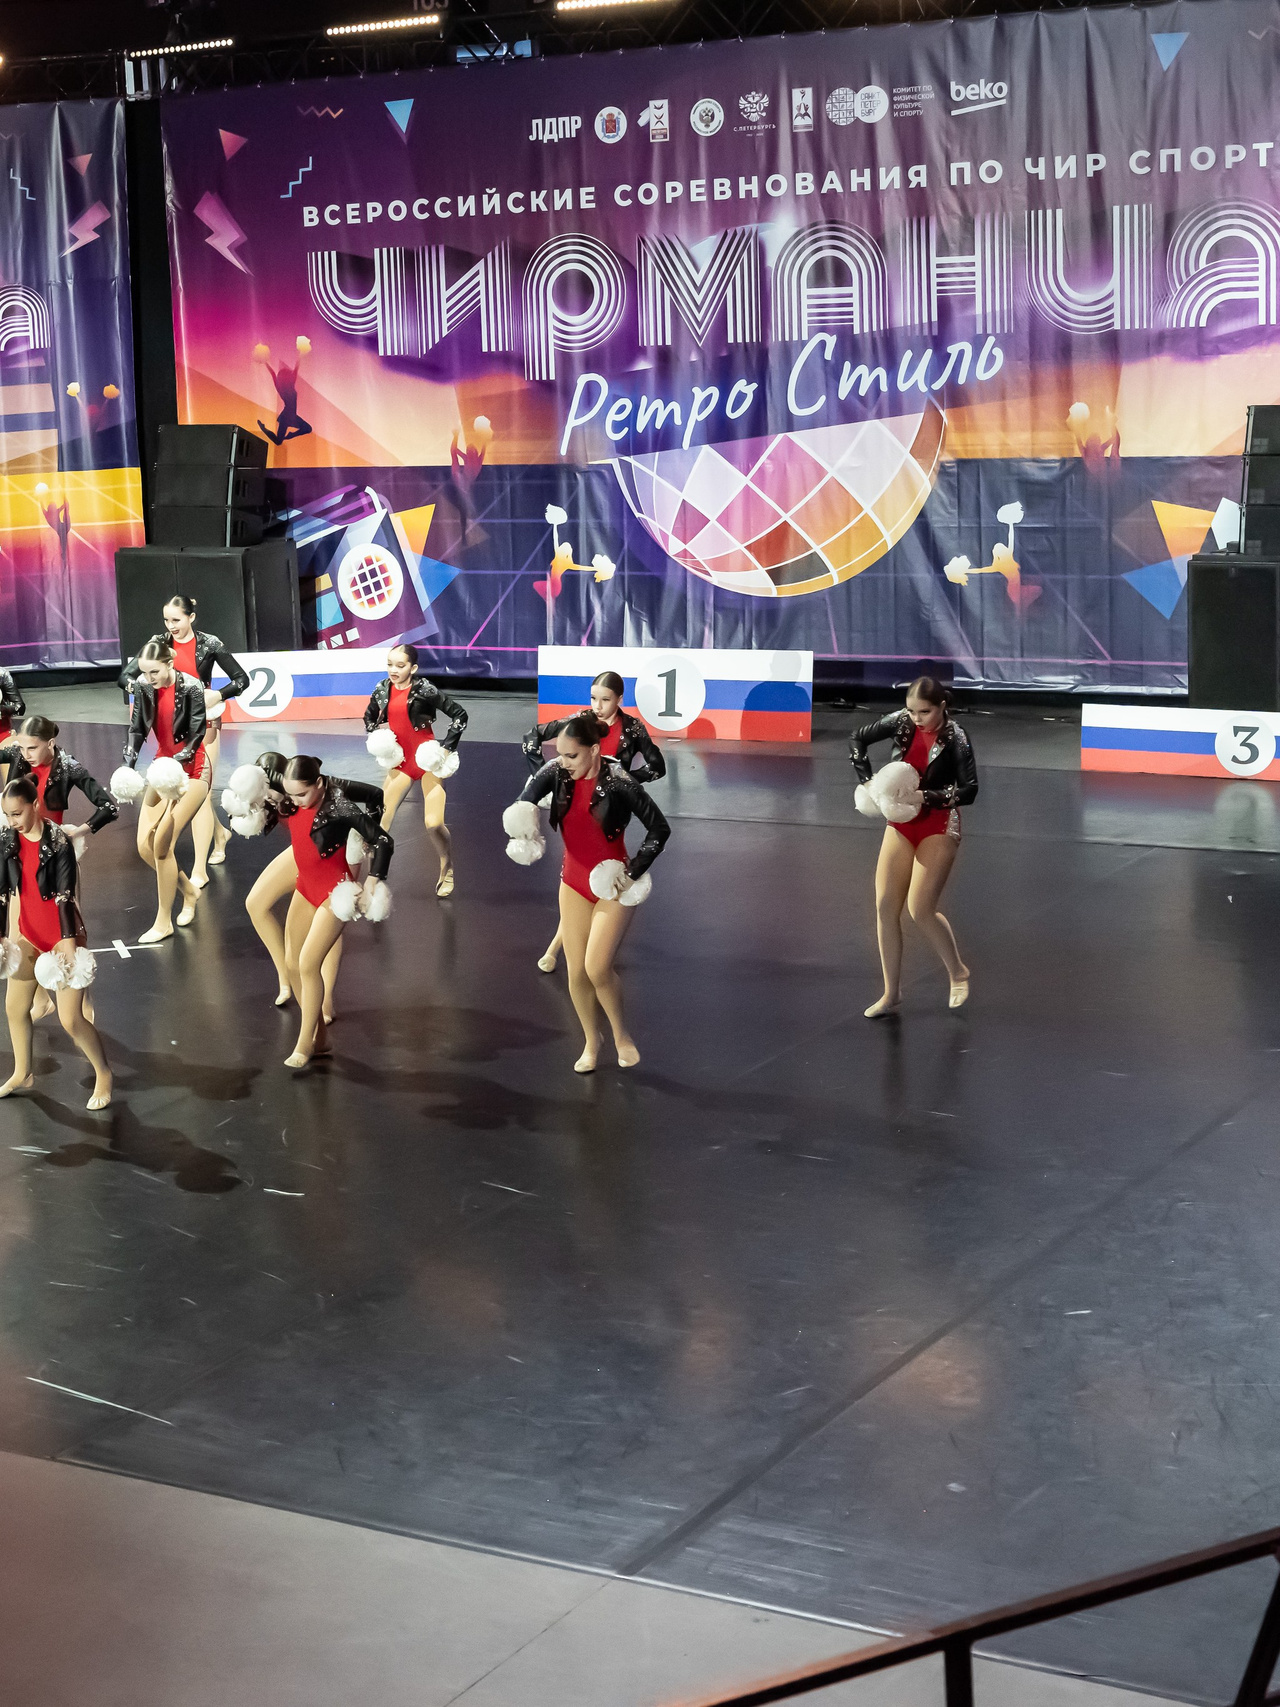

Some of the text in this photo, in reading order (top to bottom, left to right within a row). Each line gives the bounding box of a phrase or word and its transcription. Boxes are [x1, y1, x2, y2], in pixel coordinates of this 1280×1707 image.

[893, 86, 921, 94] КОМИТЕТ
[893, 91, 935, 101] ФИЗИЧЕСКОЙ
[950, 78, 1008, 101] beko
[529, 116, 582, 143] ЛДПР
[303, 142, 1274, 227] ВСЕРОССИЙСКИЕ СОРЕВНОВАНИЯ ПО ЧИР СПОРТ
[560, 332, 1004, 456] Ретро Стиль
[249, 667, 277, 707] 2
[658, 669, 682, 717] 1
[1231, 726, 1259, 765] 3
